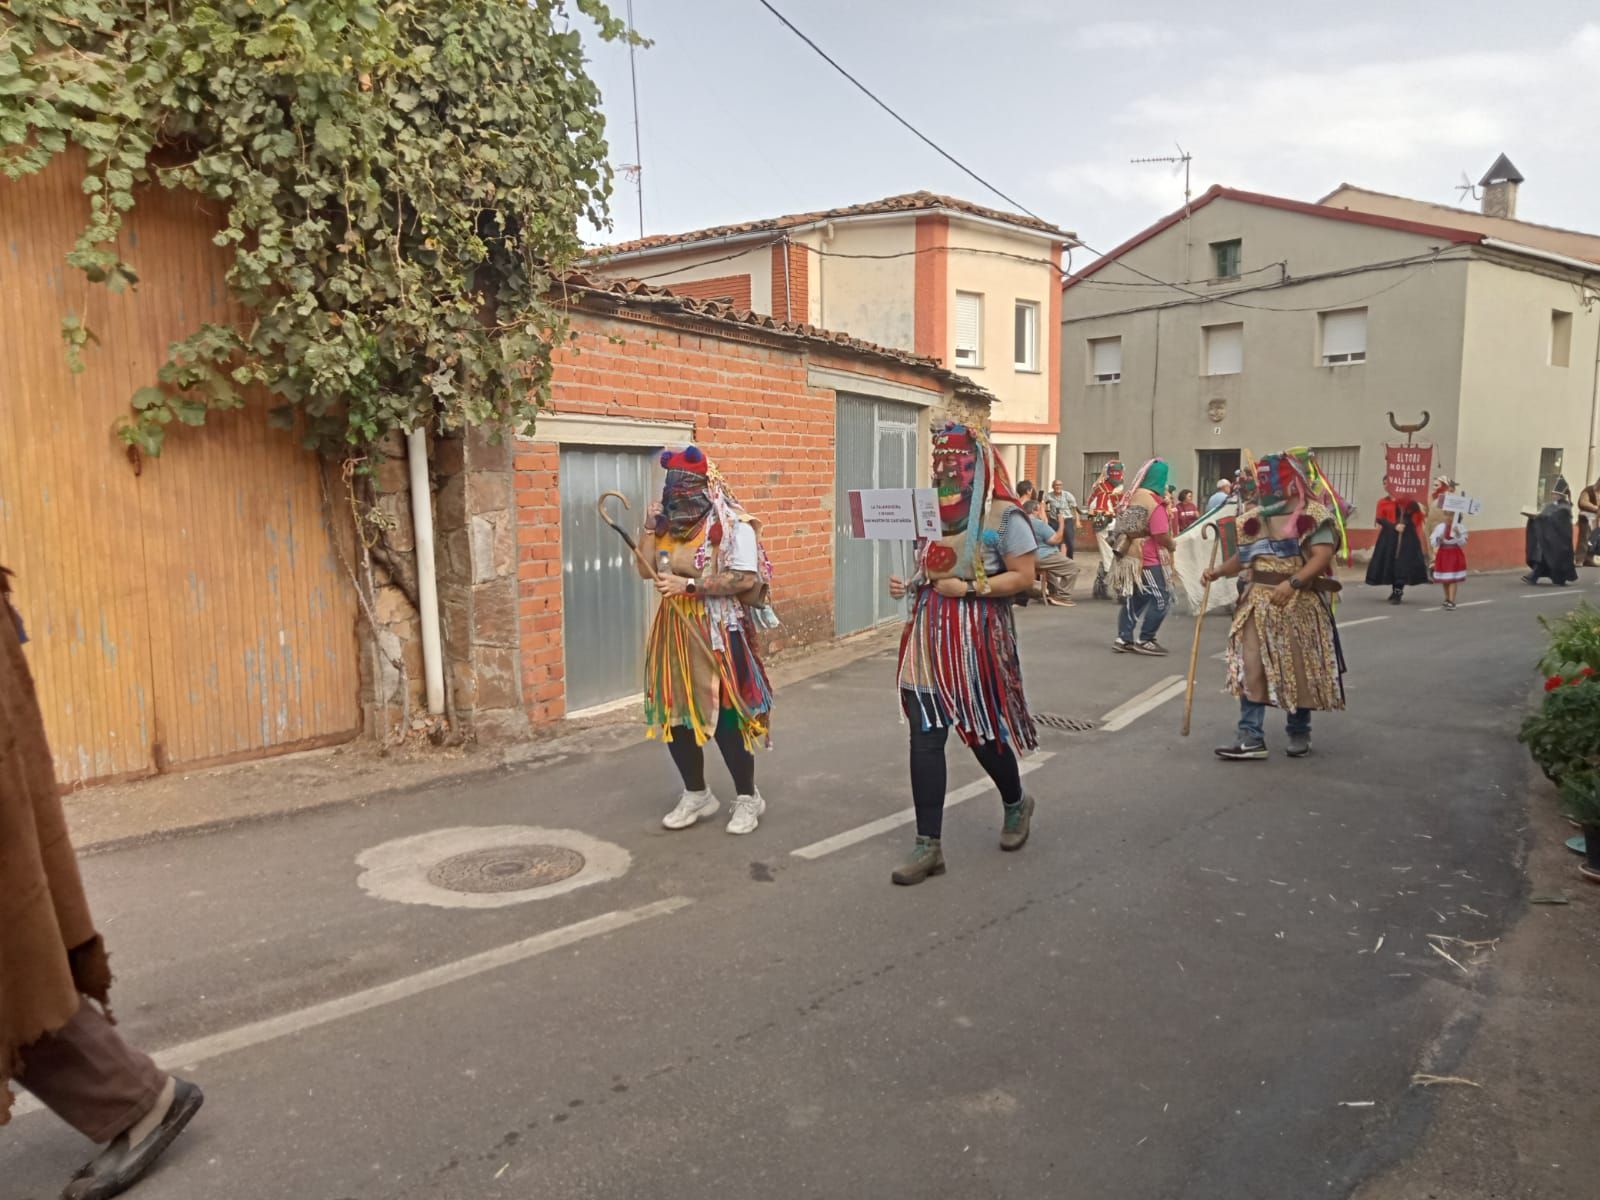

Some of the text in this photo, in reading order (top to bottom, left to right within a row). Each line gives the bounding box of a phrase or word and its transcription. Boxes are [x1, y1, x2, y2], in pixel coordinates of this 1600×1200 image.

[1397, 452, 1404, 463] EL
[1389, 463, 1426, 471] MORALES
[1389, 476, 1426, 486] VALVERDE
